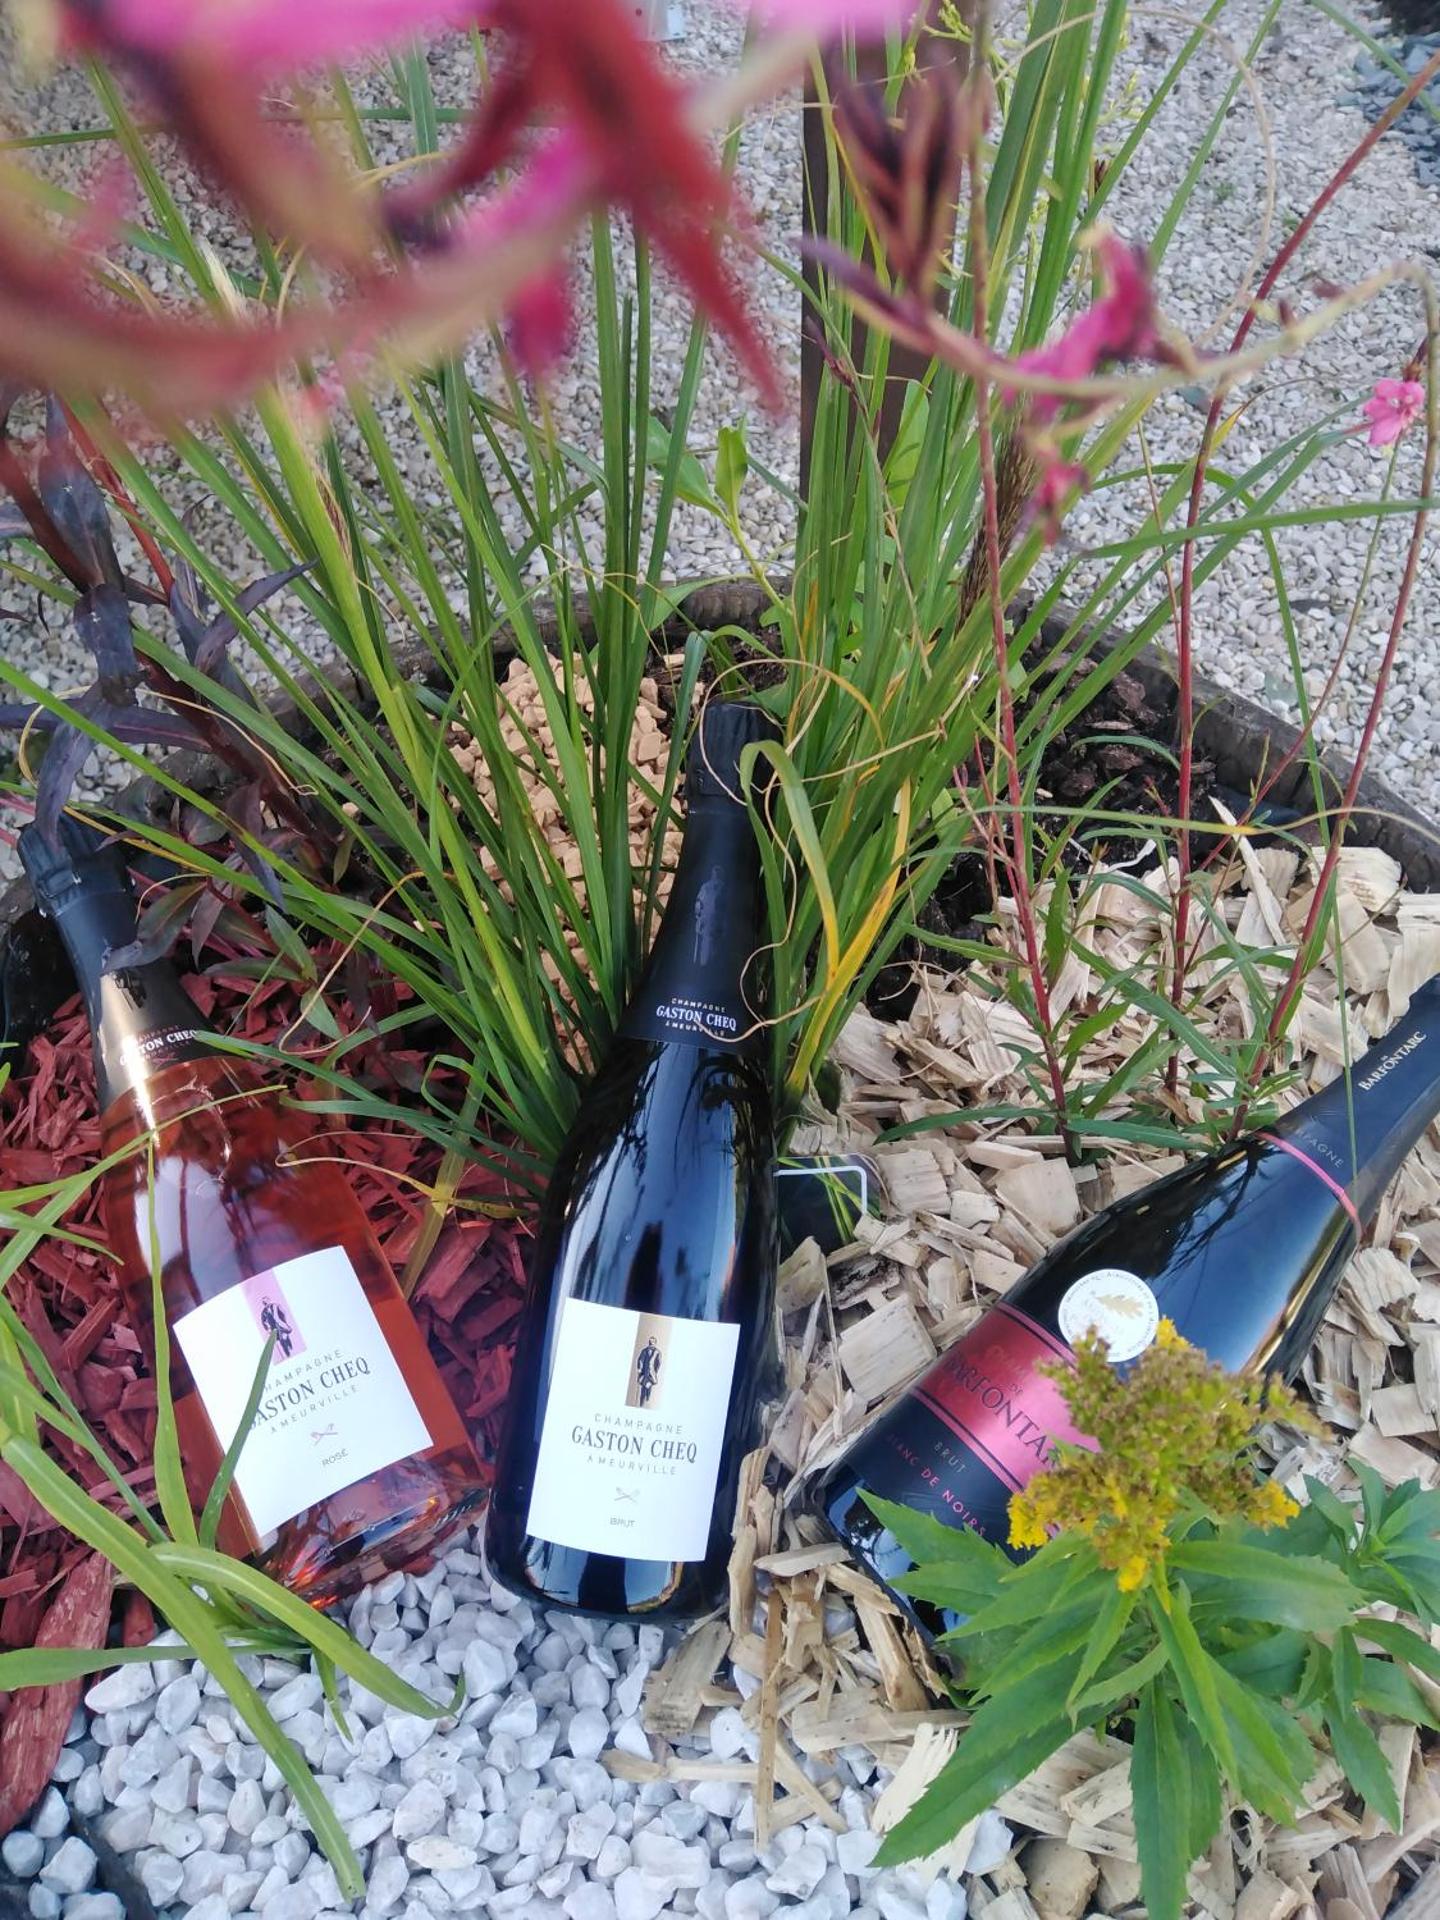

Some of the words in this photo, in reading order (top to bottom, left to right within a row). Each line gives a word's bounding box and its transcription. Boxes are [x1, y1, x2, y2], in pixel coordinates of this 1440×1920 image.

[656, 1005, 703, 1022] GASTON
[706, 1013, 737, 1032] CHEQ
[671, 998, 726, 1013] CHAMPAGNE
[264, 1349, 344, 1392] HAMPAGNE
[251, 1379, 315, 1430] ASTON
[320, 1356, 371, 1389] CHEQ
[594, 1412, 683, 1435] CHAMPAGNE
[571, 1425, 644, 1456] GASTON
[650, 1439, 698, 1464] CHEQ
[933, 1441, 967, 1474] BRUT
[921, 1466, 941, 1489] DE
[942, 1489, 986, 1538] NOIRS
